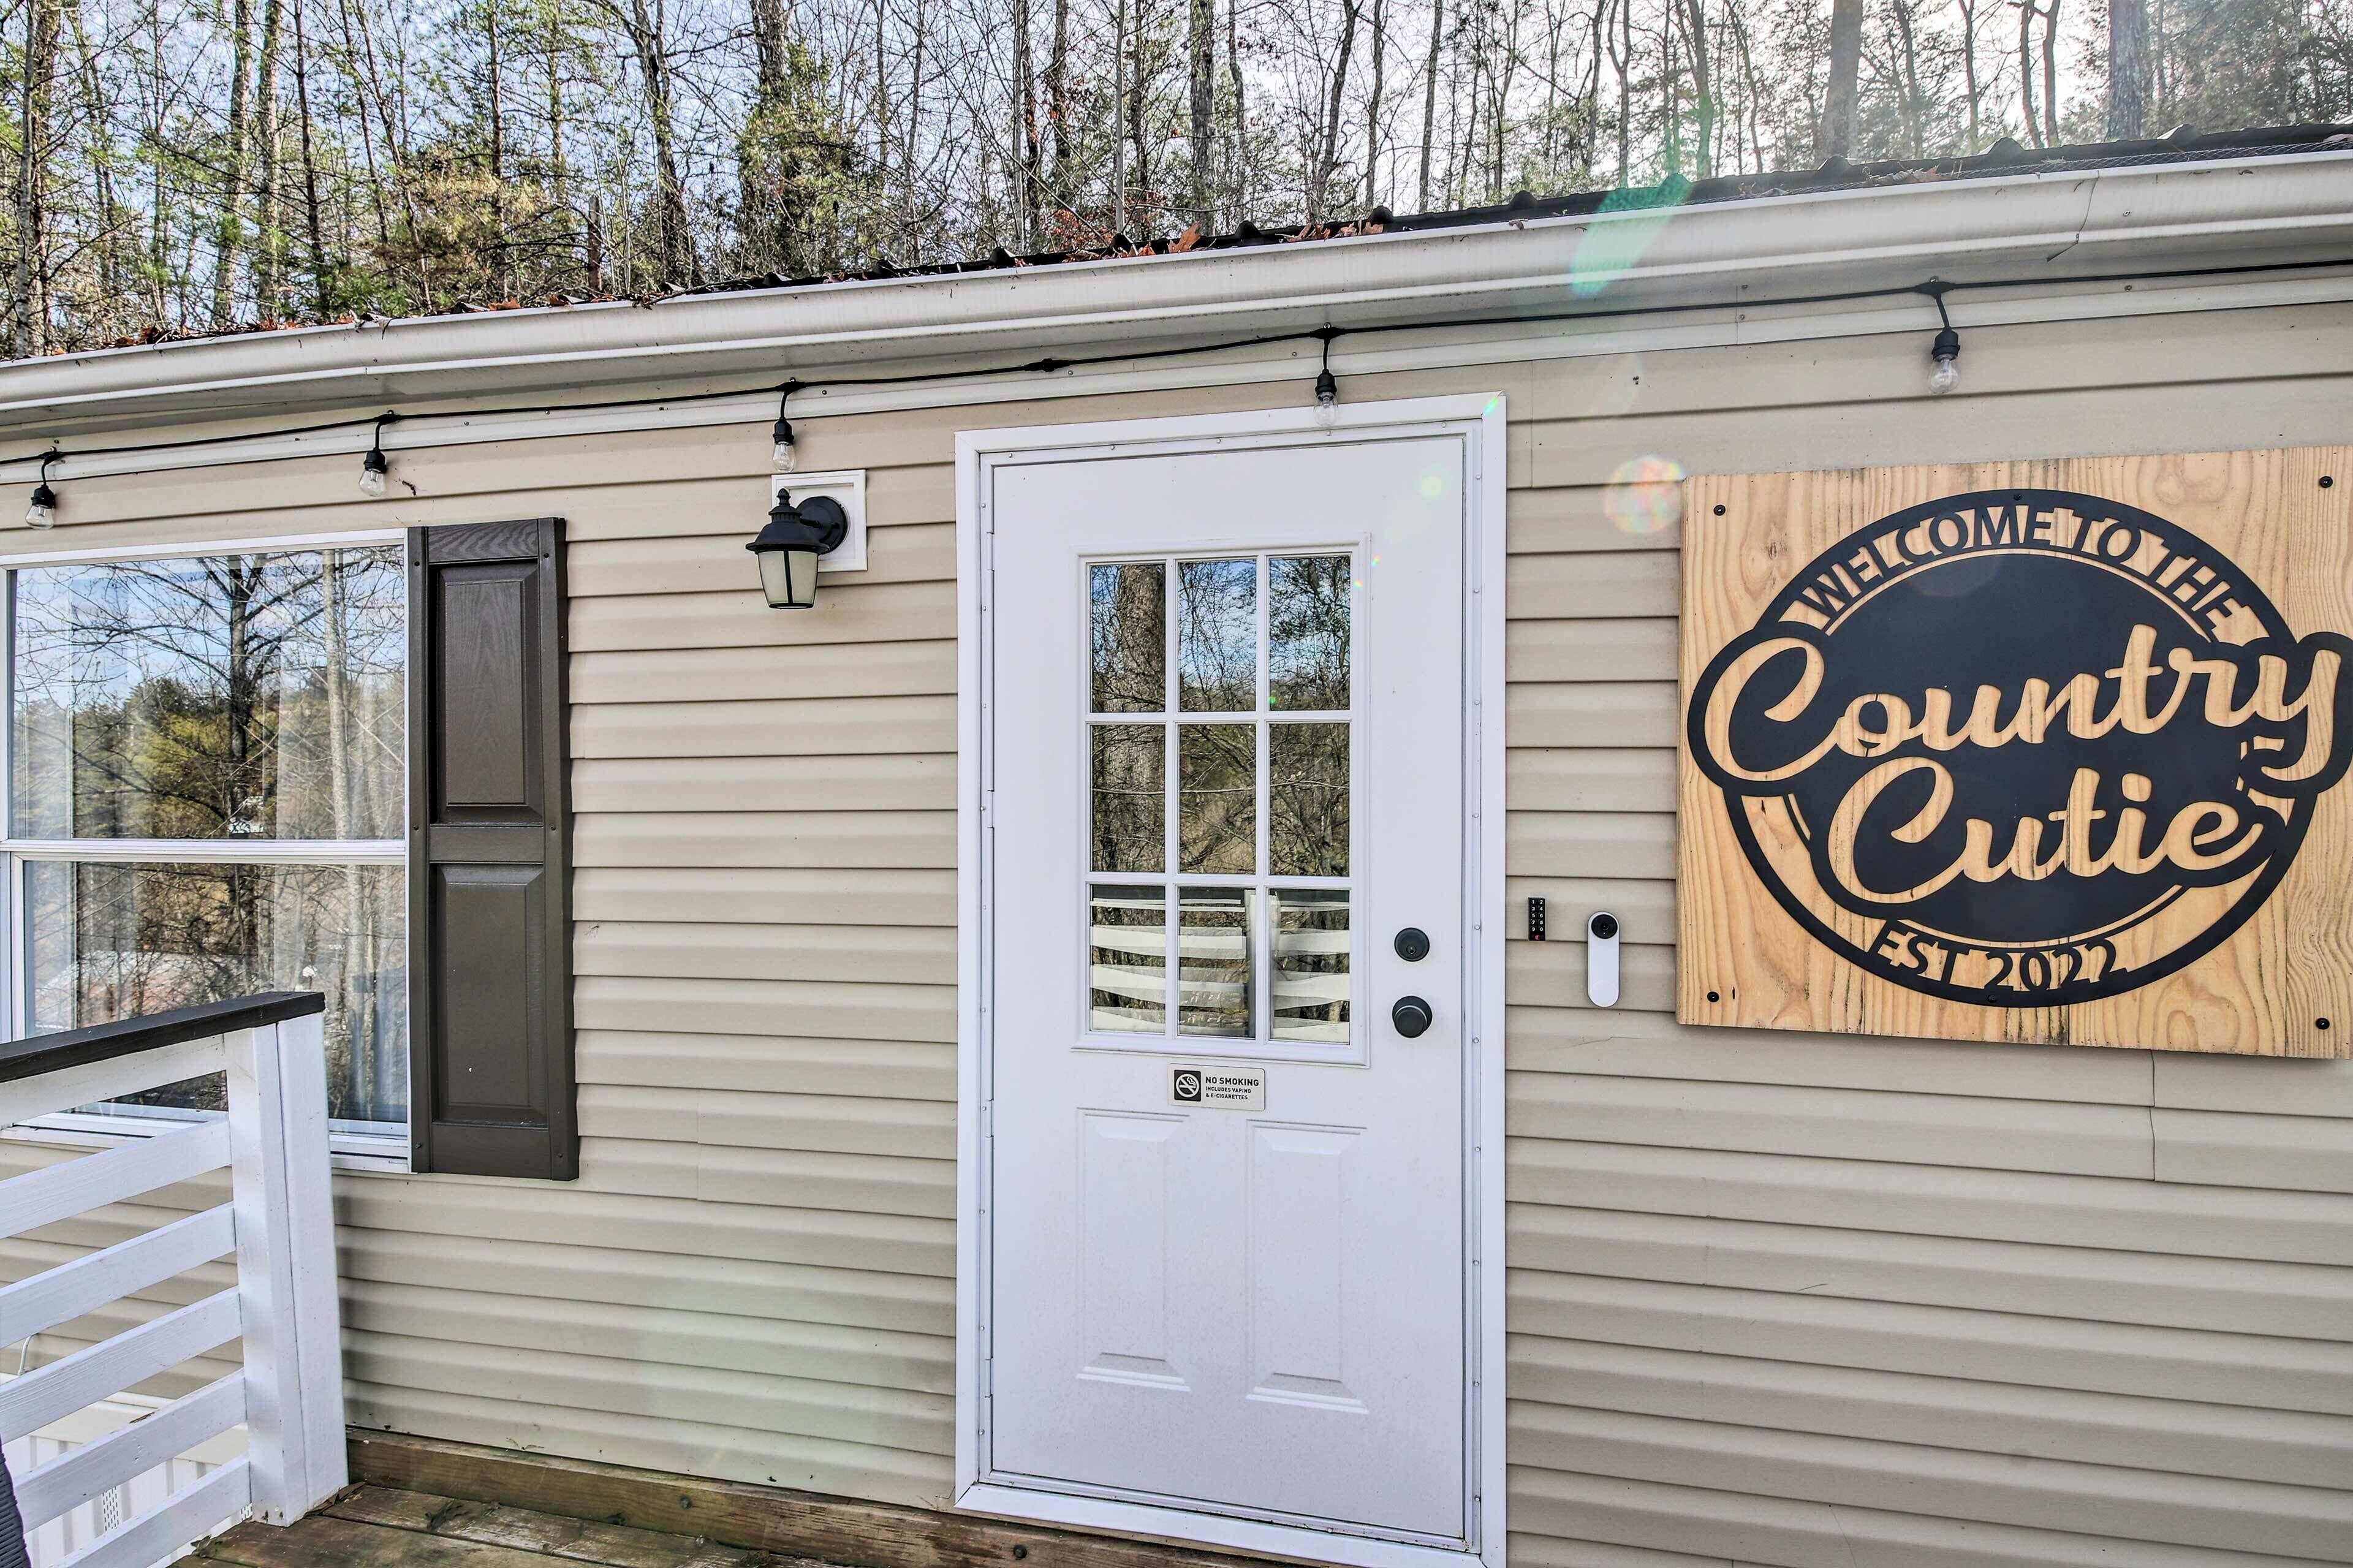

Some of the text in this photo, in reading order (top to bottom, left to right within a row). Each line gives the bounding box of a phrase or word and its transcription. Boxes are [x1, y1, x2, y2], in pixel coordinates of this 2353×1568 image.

[1795, 504, 2249, 631] WELCOME TO THE
[1704, 623, 2341, 782] Country
[1828, 756, 2263, 904] Cutie
[1867, 920, 2128, 992] EST 2022
[1219, 1077, 1259, 1086] SMOKING
